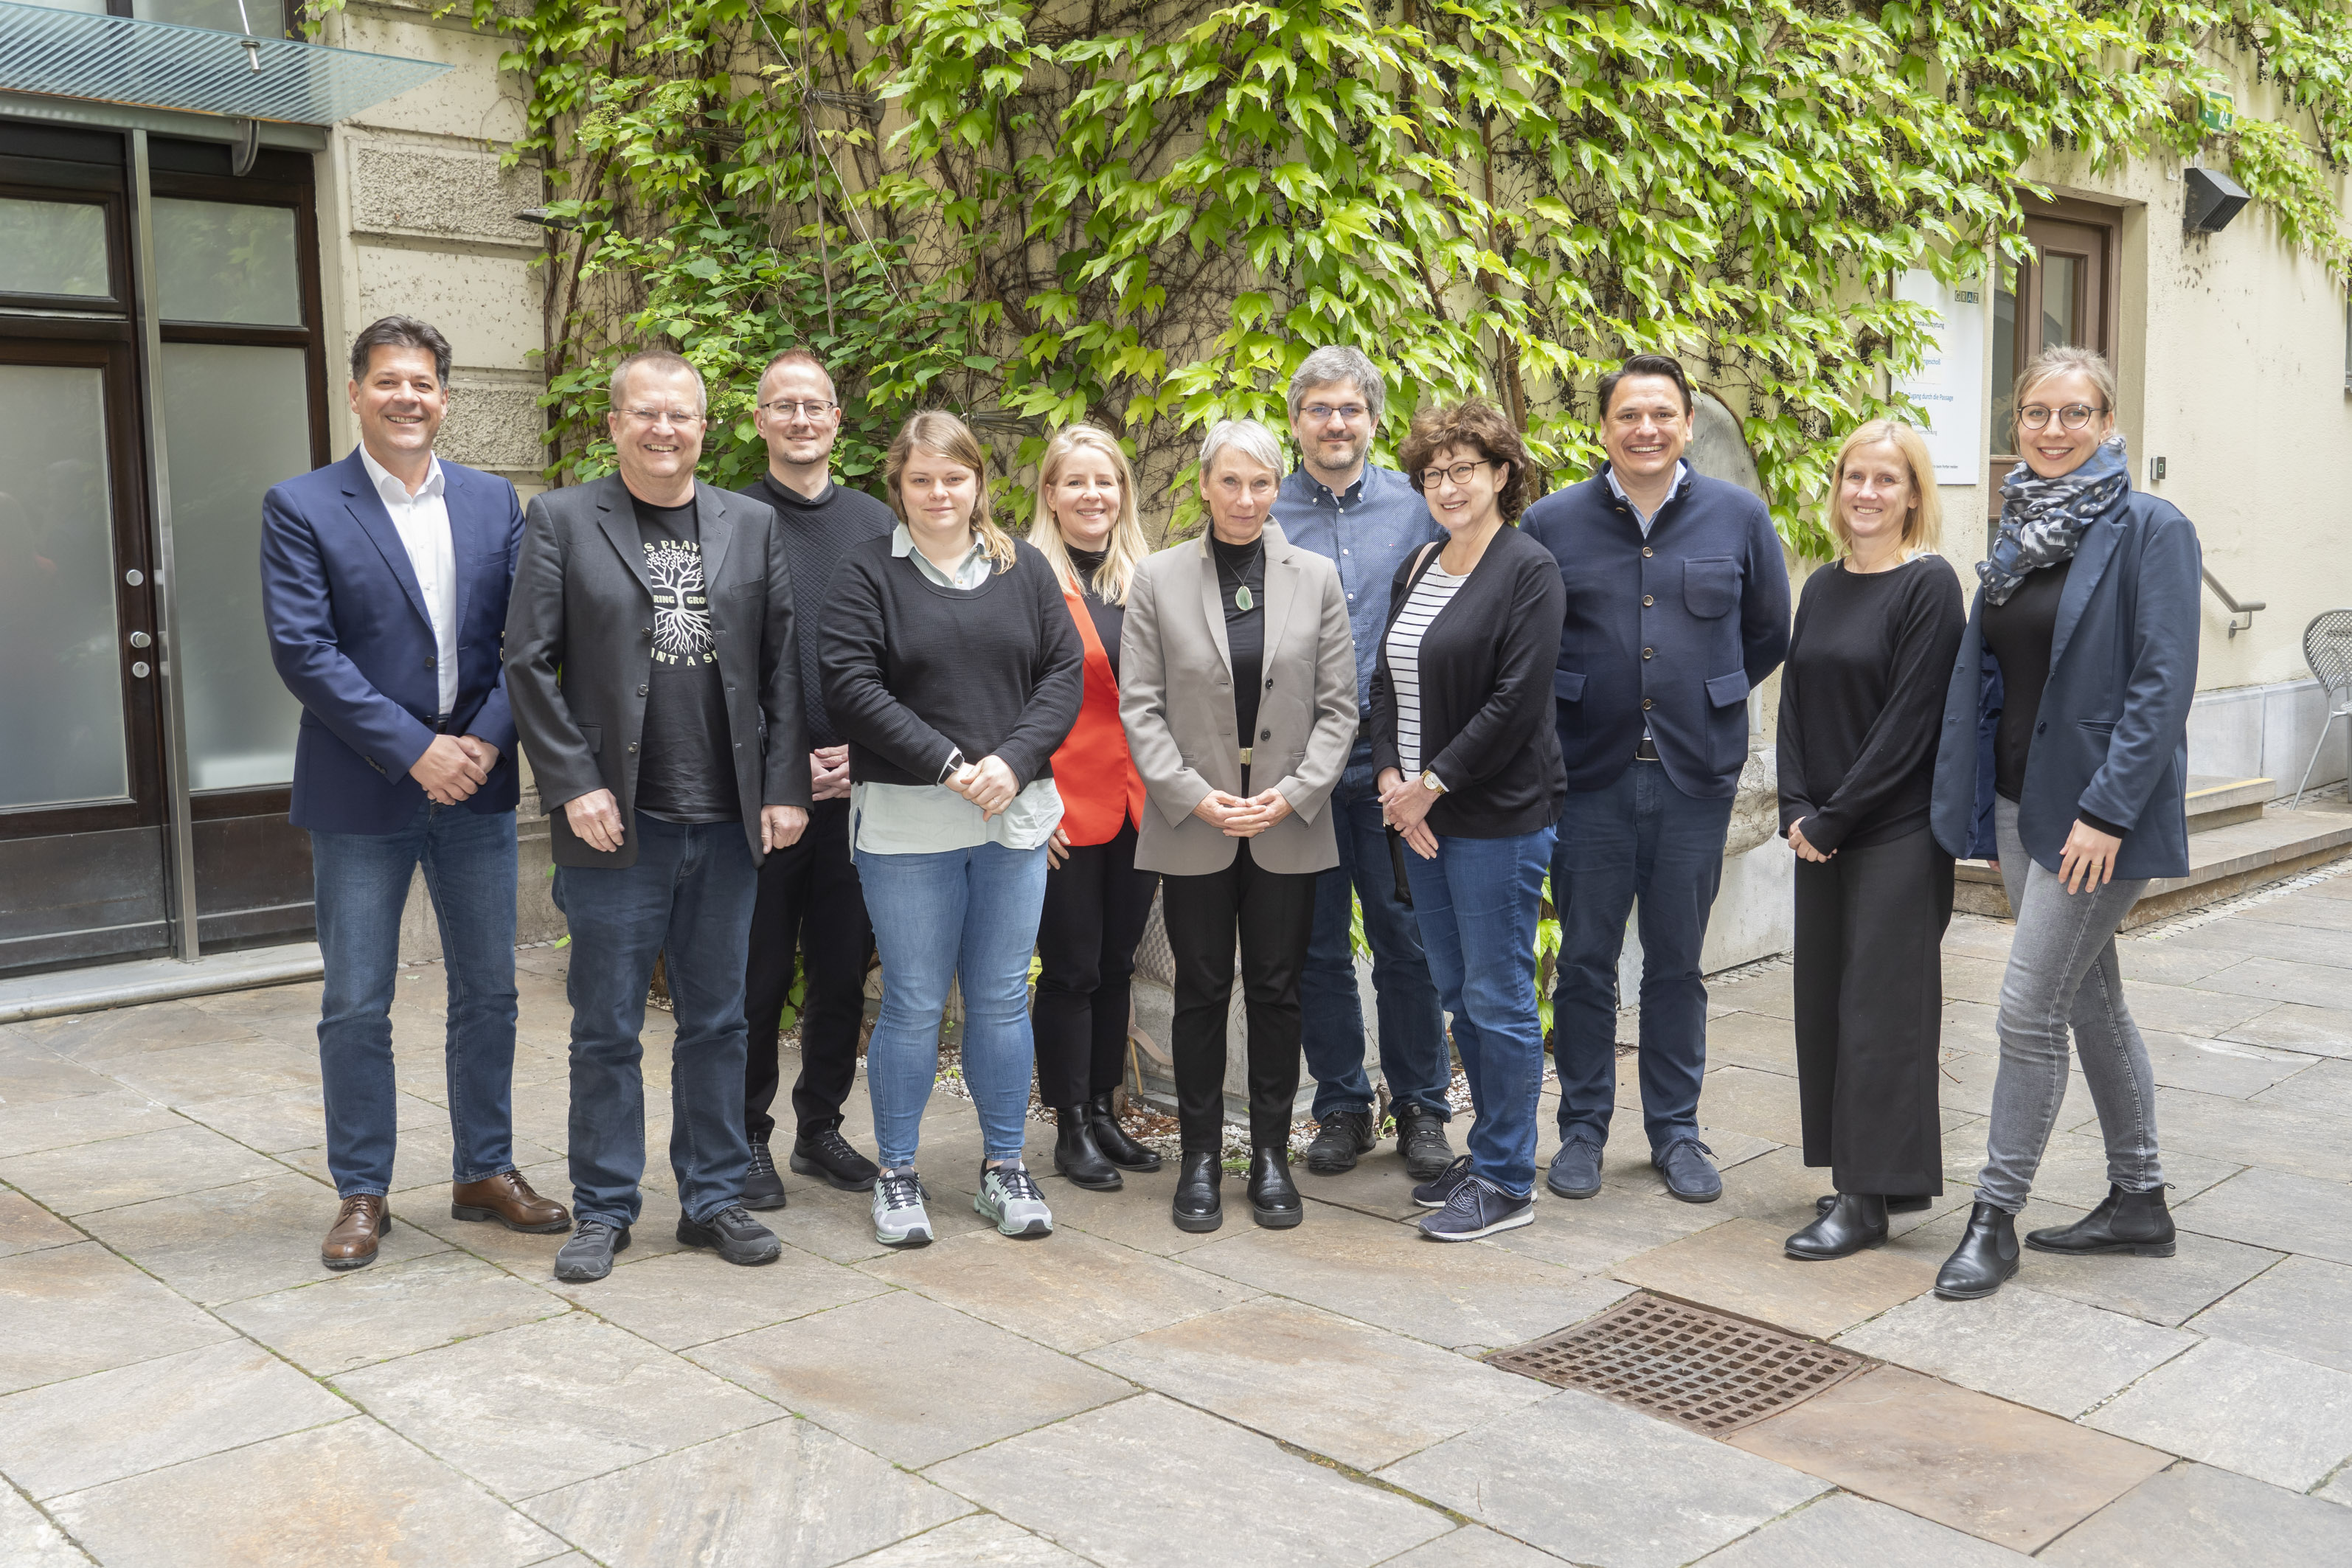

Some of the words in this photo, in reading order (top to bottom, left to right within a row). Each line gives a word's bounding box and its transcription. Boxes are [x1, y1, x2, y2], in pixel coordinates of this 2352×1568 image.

[1955, 291, 1978, 303] GRAZ
[660, 540, 700, 552] PLAY
[687, 656, 696, 666] A
